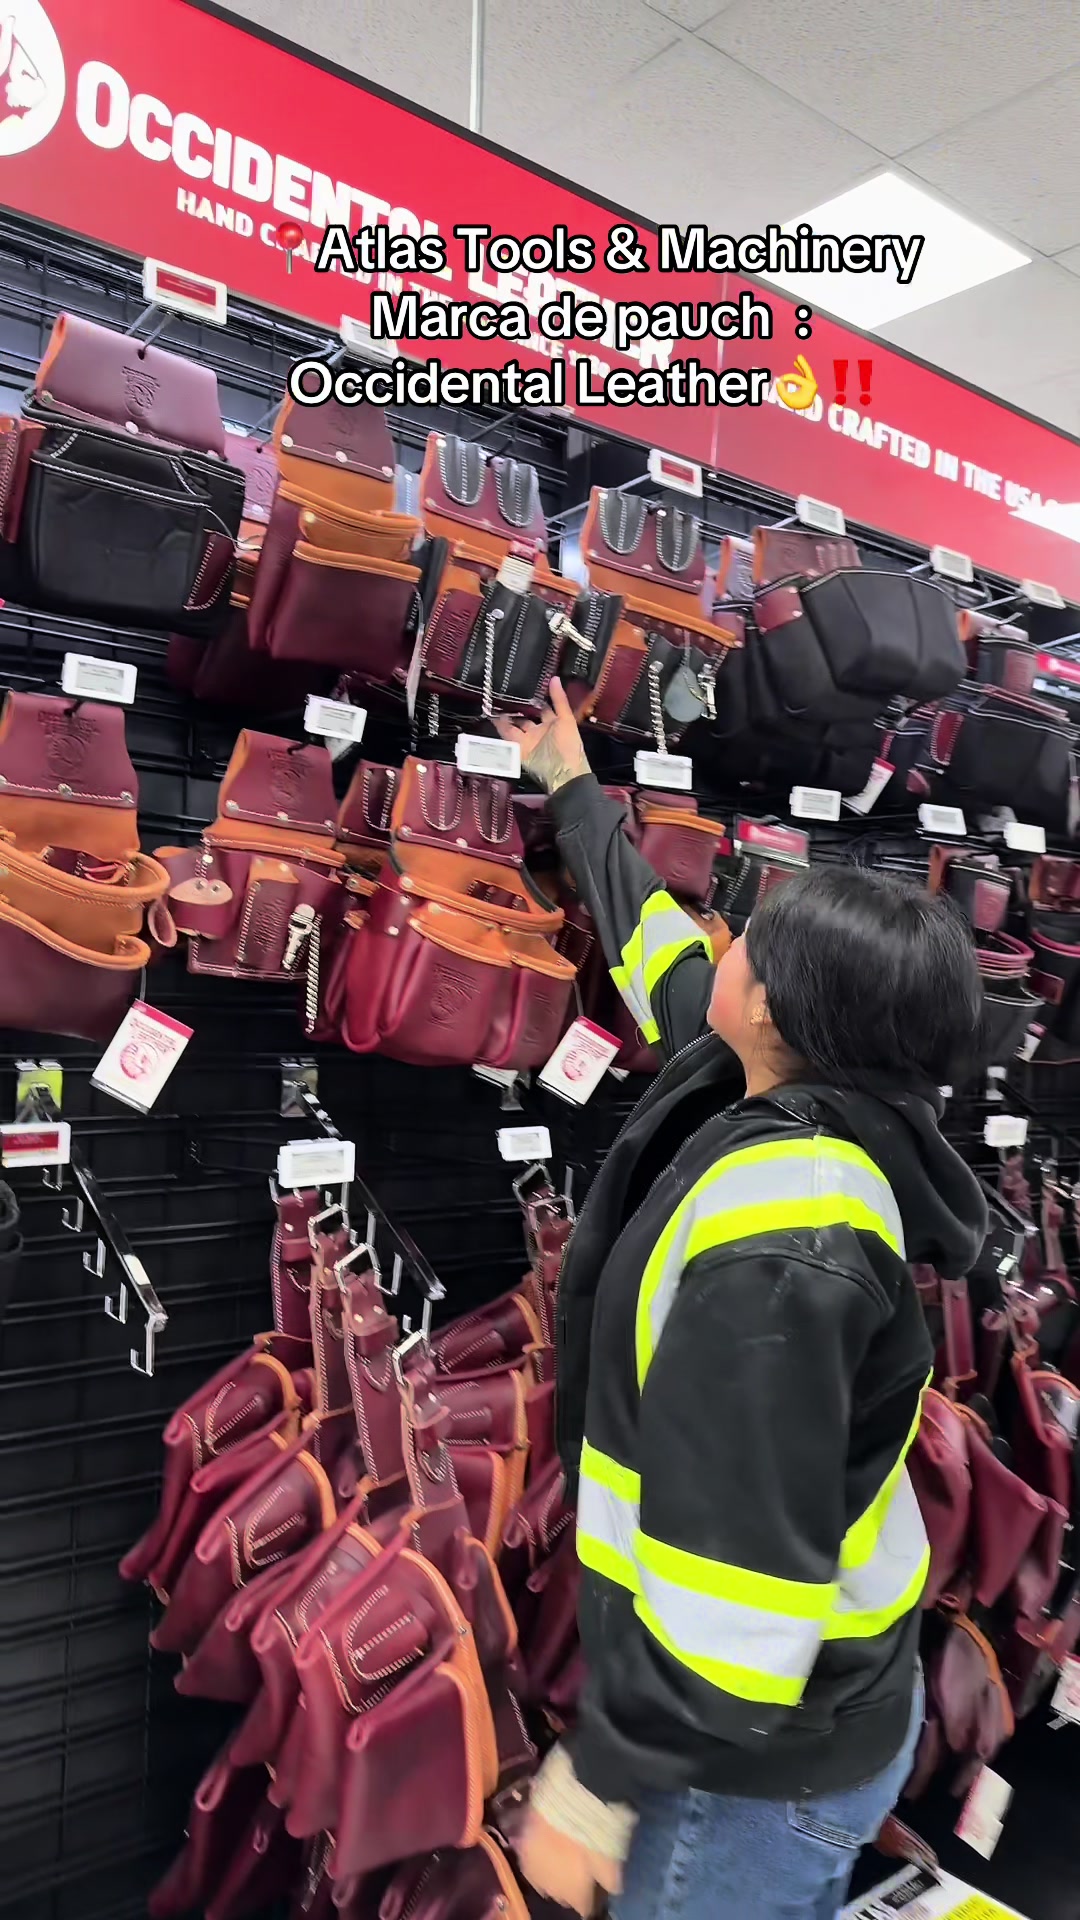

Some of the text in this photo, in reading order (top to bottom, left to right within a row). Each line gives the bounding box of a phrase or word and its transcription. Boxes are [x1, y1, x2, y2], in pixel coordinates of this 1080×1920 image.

[176, 186, 254, 238] HAND
[827, 403, 931, 469] CRAFTED
[934, 448, 959, 482] IN
[961, 460, 1003, 501] THE
